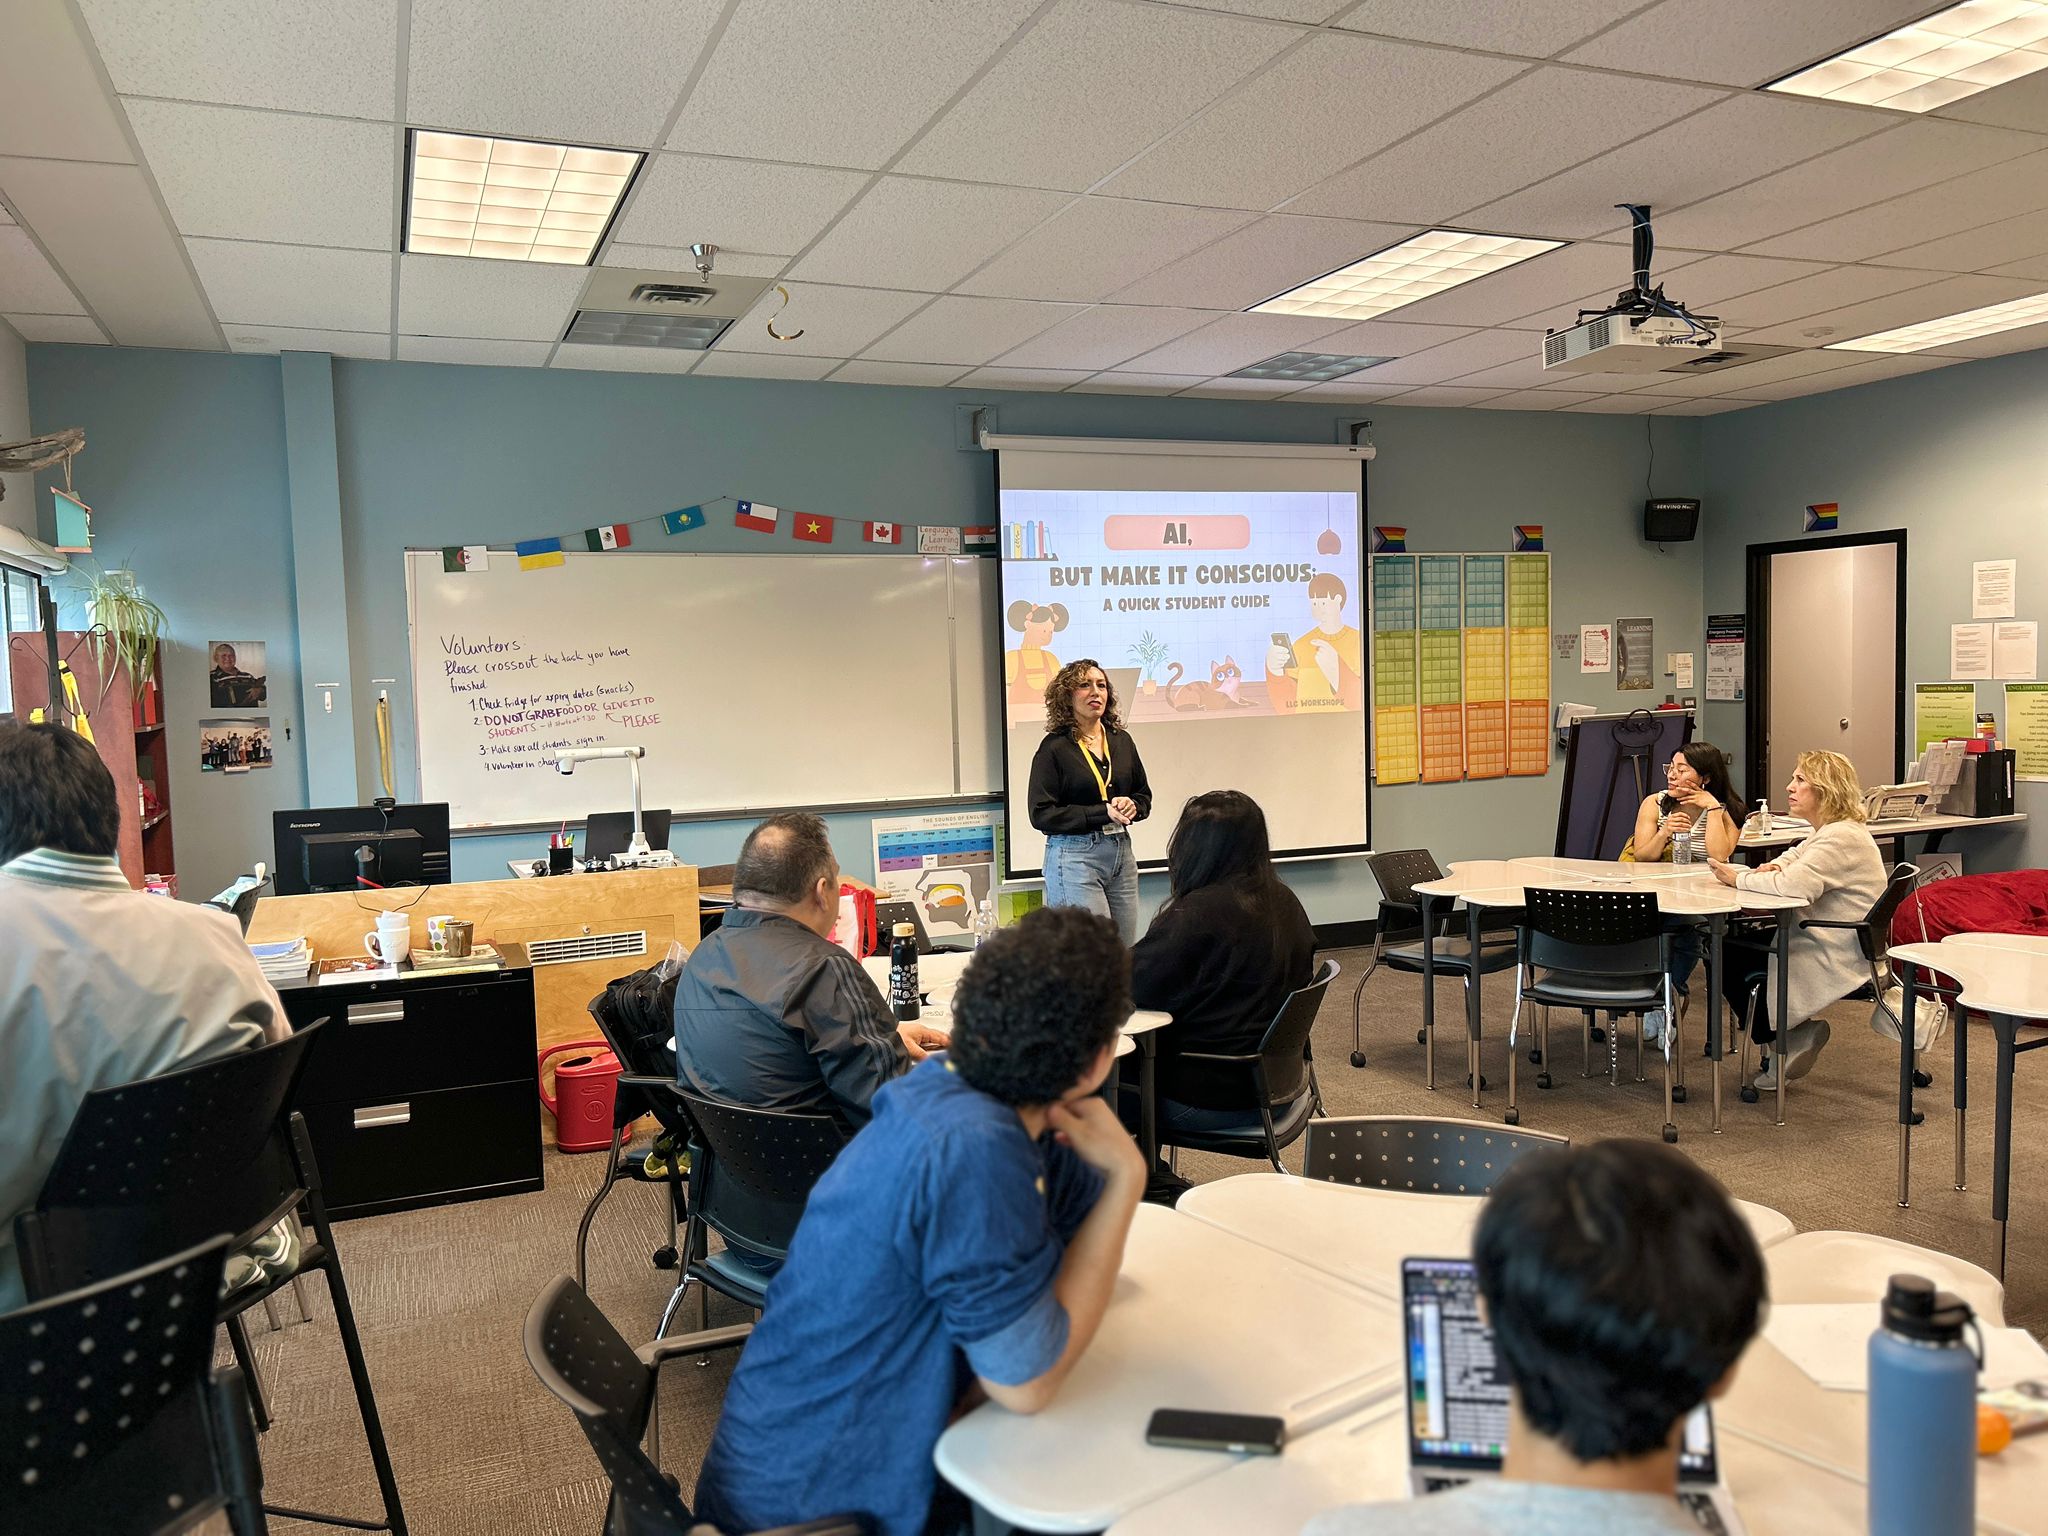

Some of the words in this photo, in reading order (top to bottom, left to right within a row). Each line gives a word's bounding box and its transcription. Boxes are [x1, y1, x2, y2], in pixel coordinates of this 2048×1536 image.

[920, 527, 953, 536] Language
[1163, 523, 1192, 546] AI,
[928, 536, 959, 546] Learning
[1050, 566, 1092, 586] BUT
[1101, 566, 1160, 586] MAKE
[1168, 565, 1187, 585] IT
[1103, 598, 1113, 612] A
[1118, 597, 1160, 612] QUICK
[1165, 596, 1226, 610] STUDENT
[1231, 595, 1270, 609] GUIDE
[444, 659, 480, 676] Please
[543, 653, 559, 665] the
[587, 651, 604, 666] you
[608, 646, 631, 657] have
[530, 694, 542, 707] for
[596, 681, 635, 697] (snacks)
[603, 701, 629, 712] GIVE
[1300, 698, 1345, 707] WORKSHOPS
[622, 713, 662, 728] PLEASE
[488, 723, 537, 740] STUDENTS
[576, 736, 594, 749] sign
